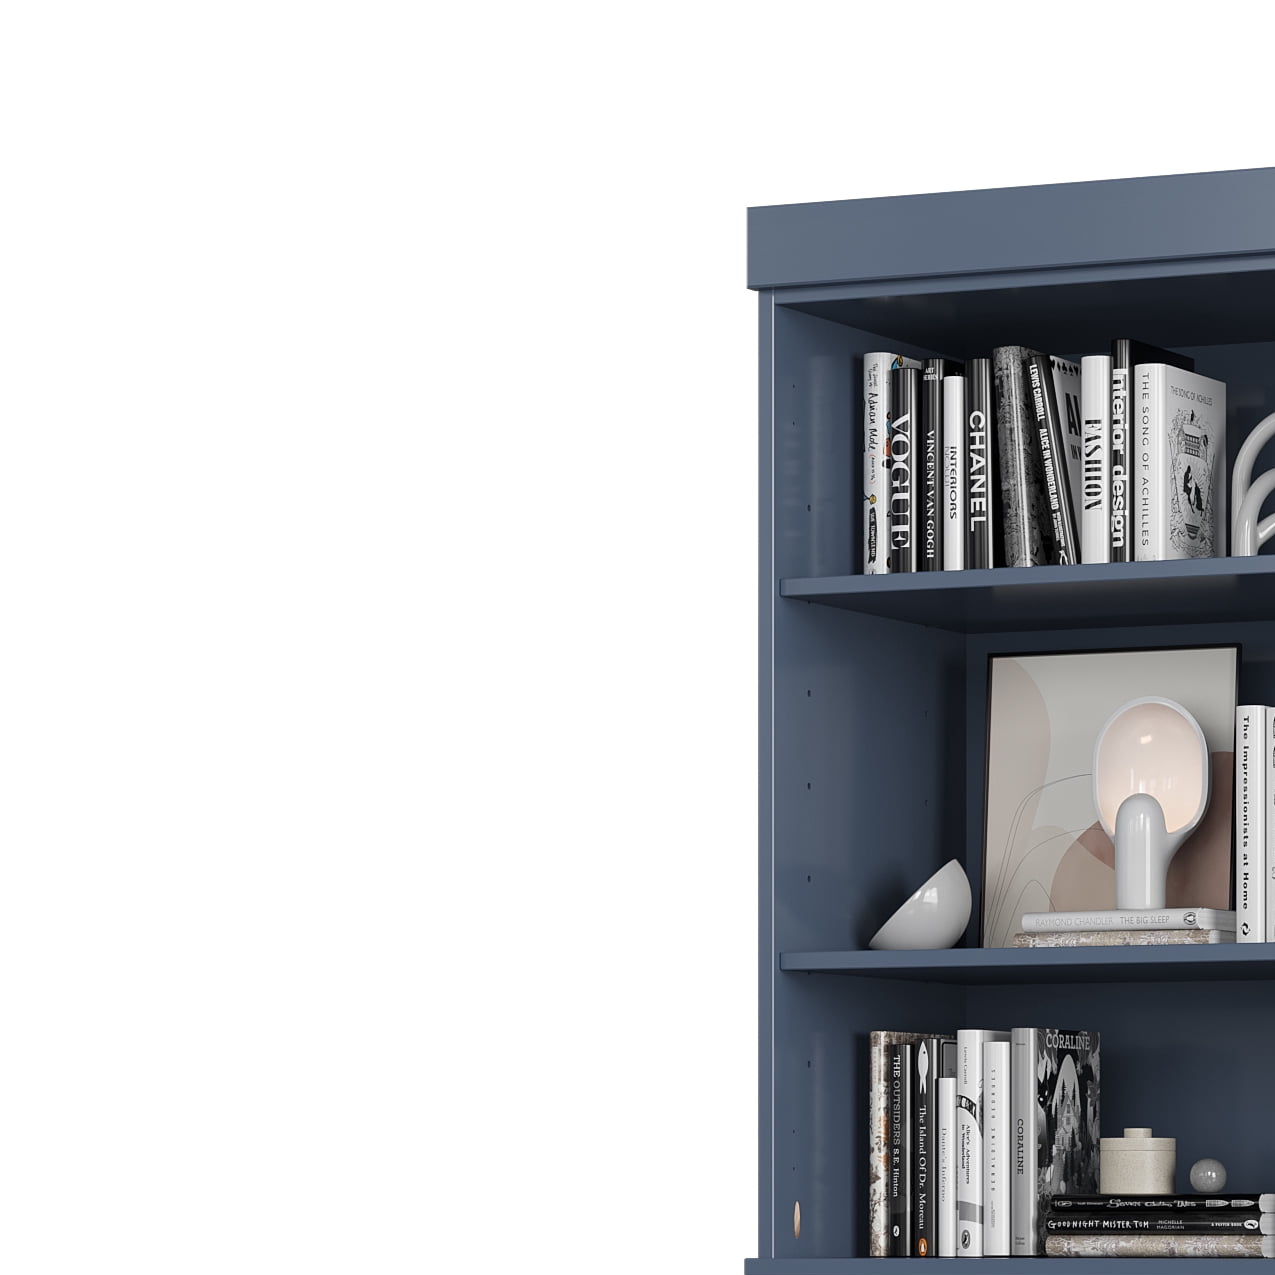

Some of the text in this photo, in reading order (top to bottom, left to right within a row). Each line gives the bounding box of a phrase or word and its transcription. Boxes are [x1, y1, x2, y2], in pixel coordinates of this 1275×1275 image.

[1029, 364, 1045, 421] LEWIS CARROLL
[1039, 428, 1050, 449] ALICE
[1042, 449, 1052, 459] IN
[1084, 419, 1102, 511] FASHION
[1110, 368, 1129, 548] Interior design
[1142, 372, 1150, 547] THE SONG OF ACHILLES
[891, 411, 911, 550] VOGUE
[926, 430, 935, 558] VINCENT VAN GOGH
[949, 446, 958, 520] INTERIORS
[969, 410, 986, 532] CHANEL
[1044, 459, 1059, 510] WONDERLAND
[1242, 745, 1251, 848] Impressionists
[1243, 853, 1250, 867] at
[1242, 872, 1250, 910] Home
[1119, 915, 1170, 926] THE BIG SLEEP
[892, 1054, 901, 1078] THE
[1046, 1032, 1091, 1050] CORALINE
[892, 1079, 901, 1145] OUTSIDERS
[919, 1105, 927, 1229] The Island Of Dr. Moreau
[940, 1127, 948, 1202] Dante's Inferno
[1016, 1118, 1024, 1175] CORALINE
[892, 1168, 900, 1197] Hinton
[1102, 1220, 1132, 1230] MISTER
